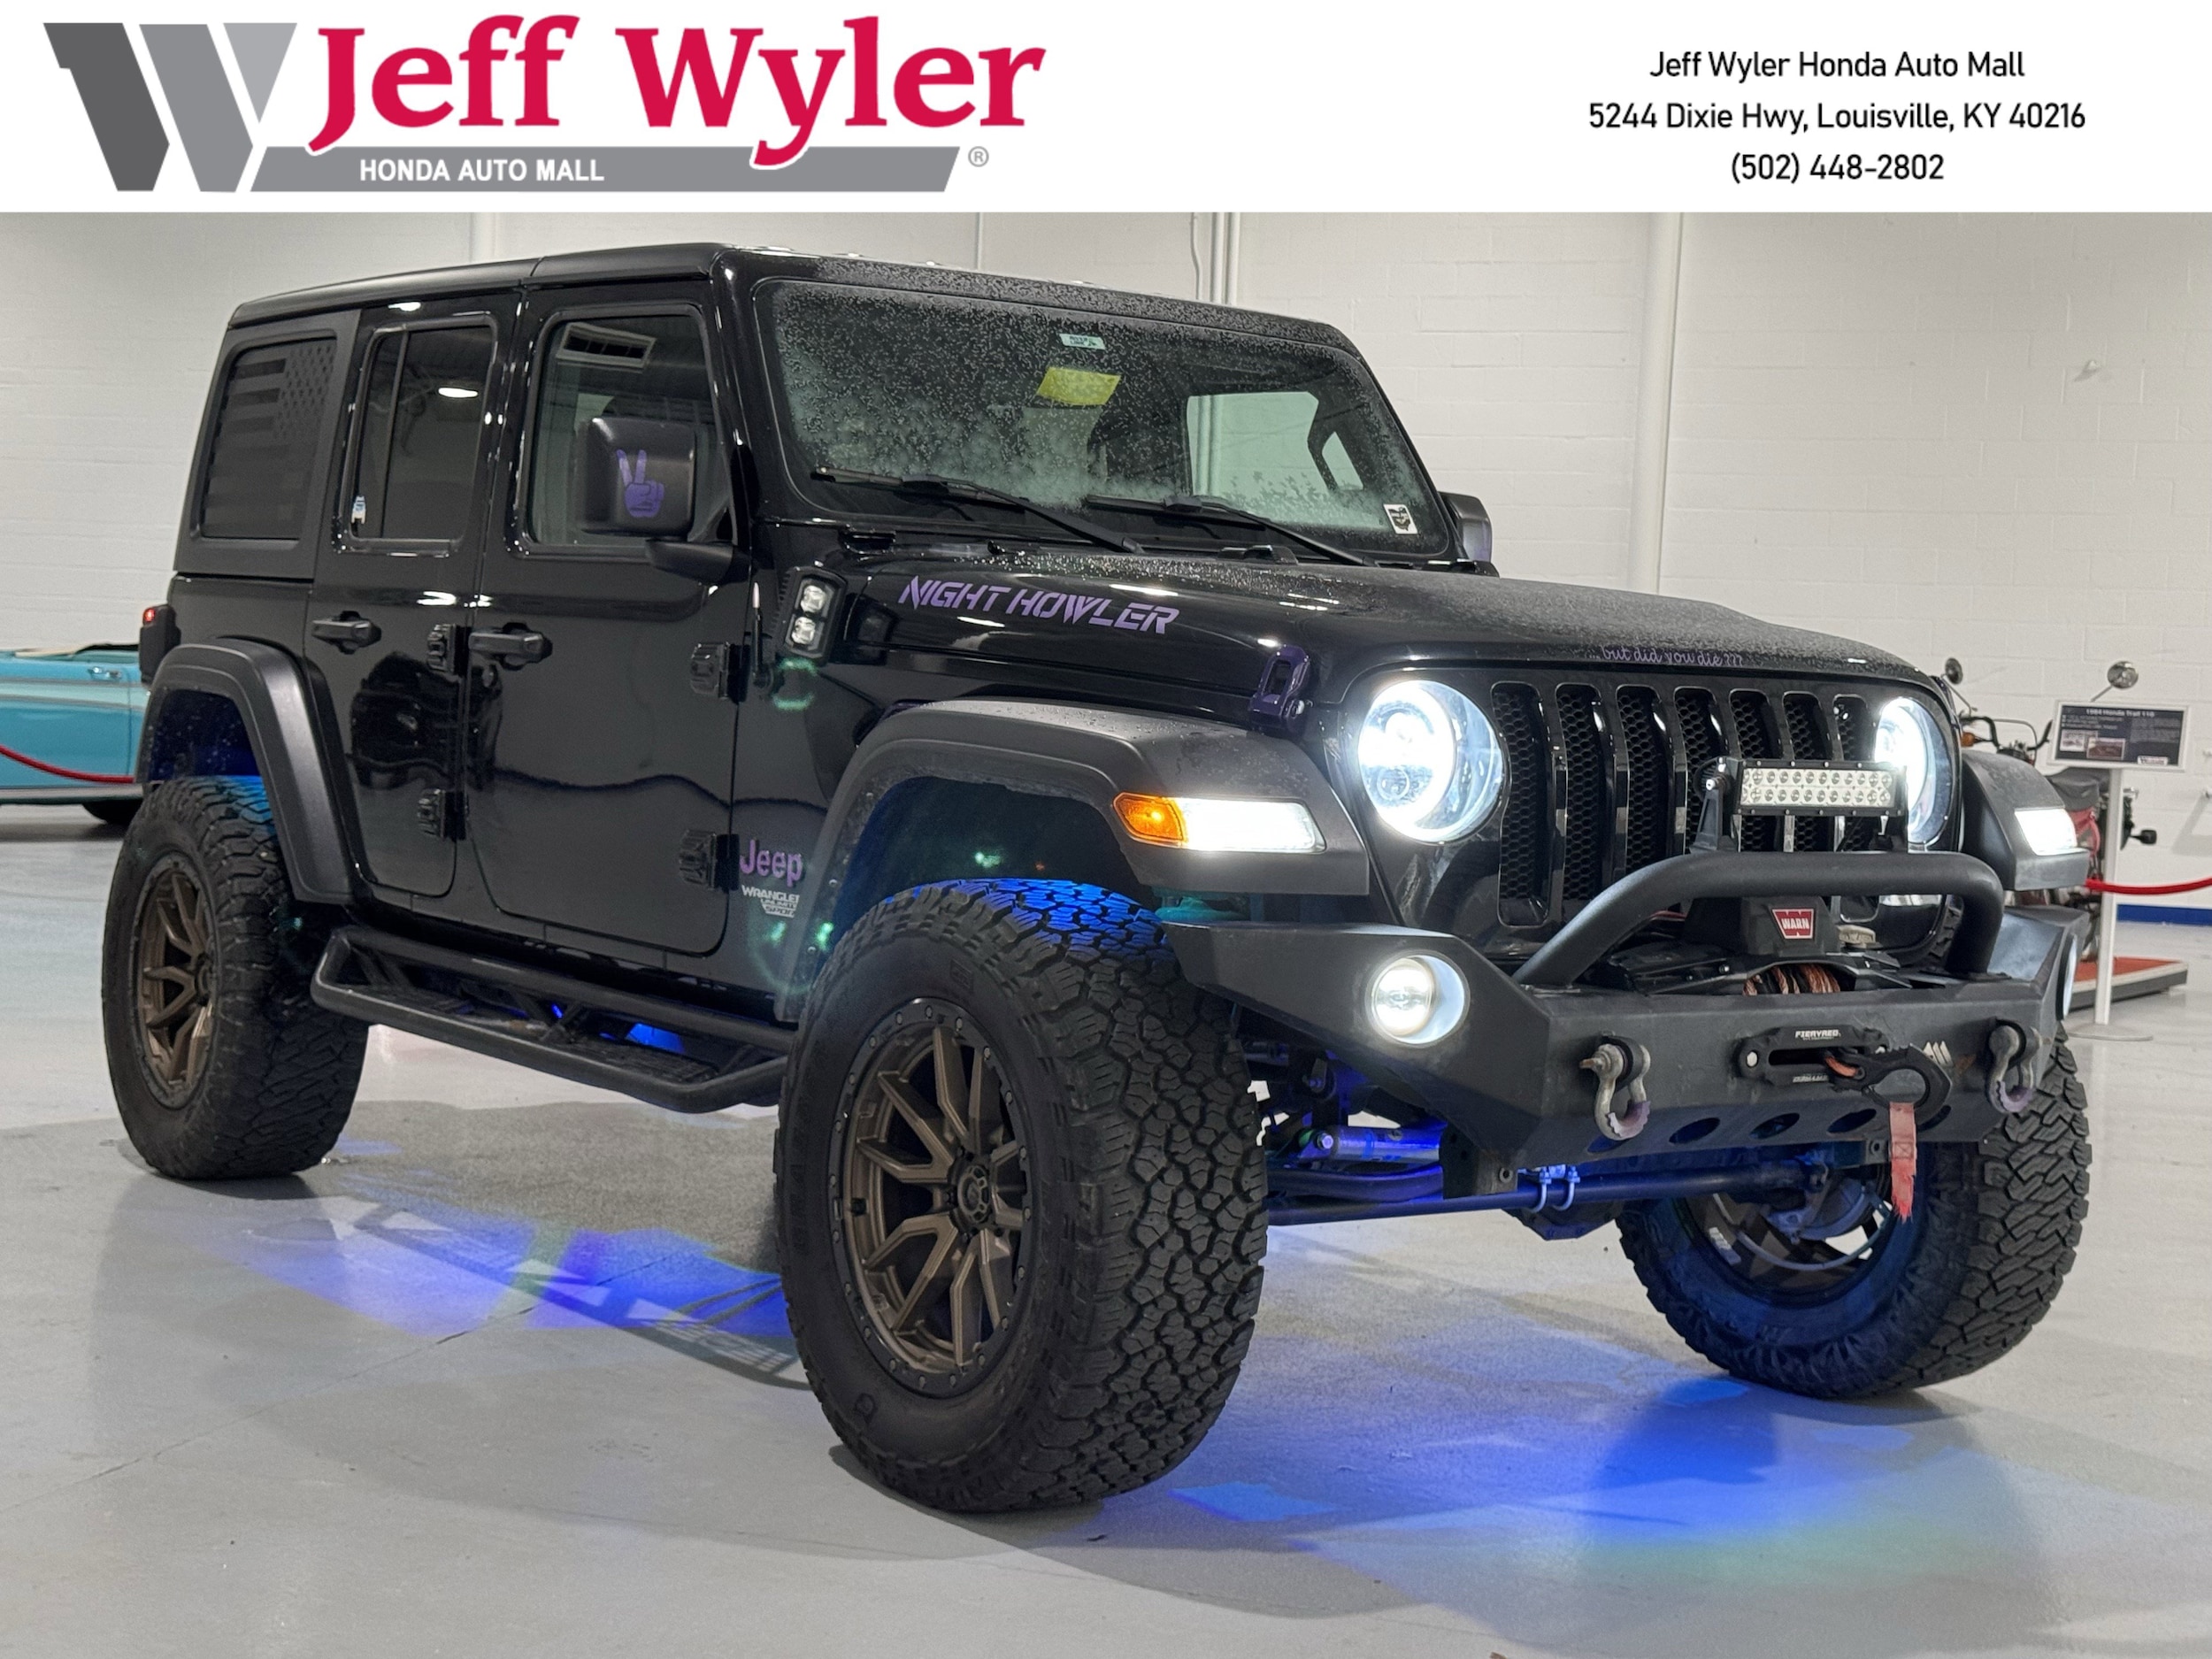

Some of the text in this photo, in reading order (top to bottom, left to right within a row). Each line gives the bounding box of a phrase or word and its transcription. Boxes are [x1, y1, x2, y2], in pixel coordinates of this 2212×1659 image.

[898, 575, 1180, 634] NIGHT HOWLER
[1633, 647, 1663, 664] did
[739, 839, 803, 887] Jeep
[1781, 918, 1810, 930] WARN
